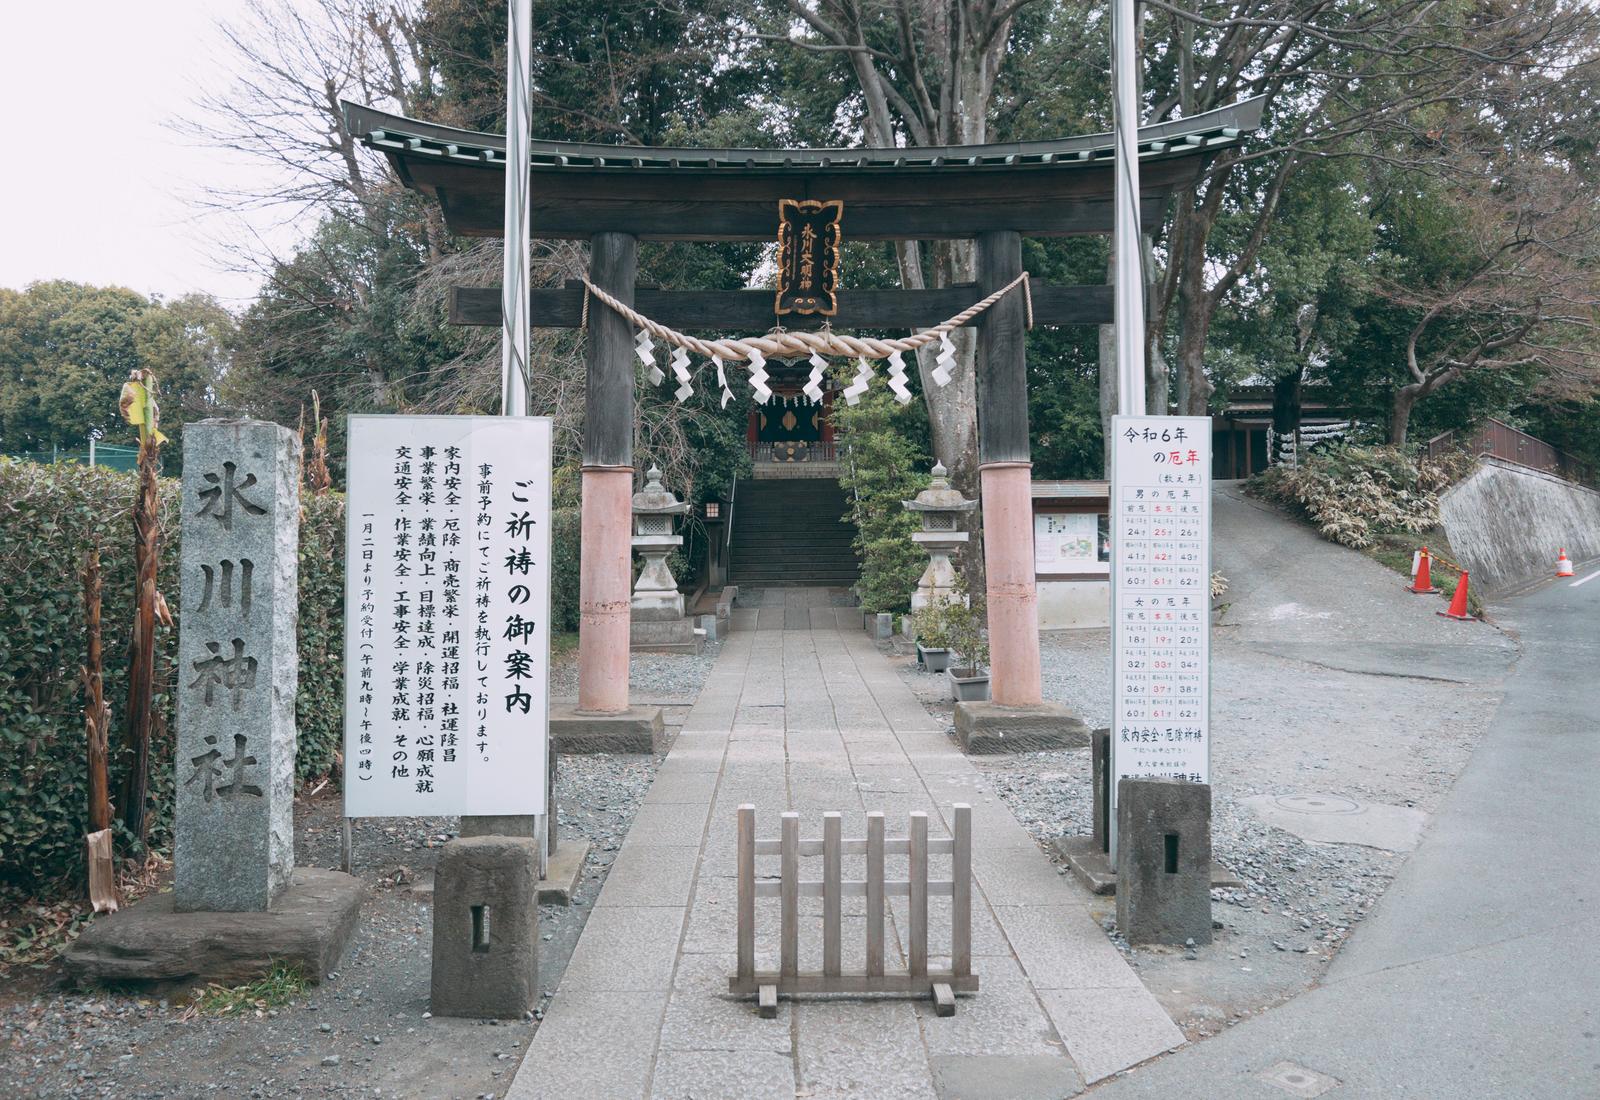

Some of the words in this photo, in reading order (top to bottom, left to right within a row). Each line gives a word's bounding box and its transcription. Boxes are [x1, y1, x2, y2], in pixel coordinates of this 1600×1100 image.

[1124, 426, 1188, 443] 令和6年
[1135, 489, 1191, 499] 男の厄年
[1153, 450, 1200, 466] の厄年
[184, 461, 268, 803] 氷川神社
[391, 446, 413, 778] 交通安全・作業安全・工事安全・学業成就・その他
[415, 446, 438, 793] 事業繁栄・業績向上・目標達成・除災招福・心願成就
[440, 446, 462, 762] 家内安全・厄除・商売繁栄・開運招福・社運隆昌
[474, 463, 493, 762] 事前予約にてご祈祷を執行しております。
[503, 479, 536, 714] ご祈祷の御案内
[1134, 597, 1191, 607] 女の厄年
[1121, 725, 1203, 743] 家内安全・厄除祈祷
